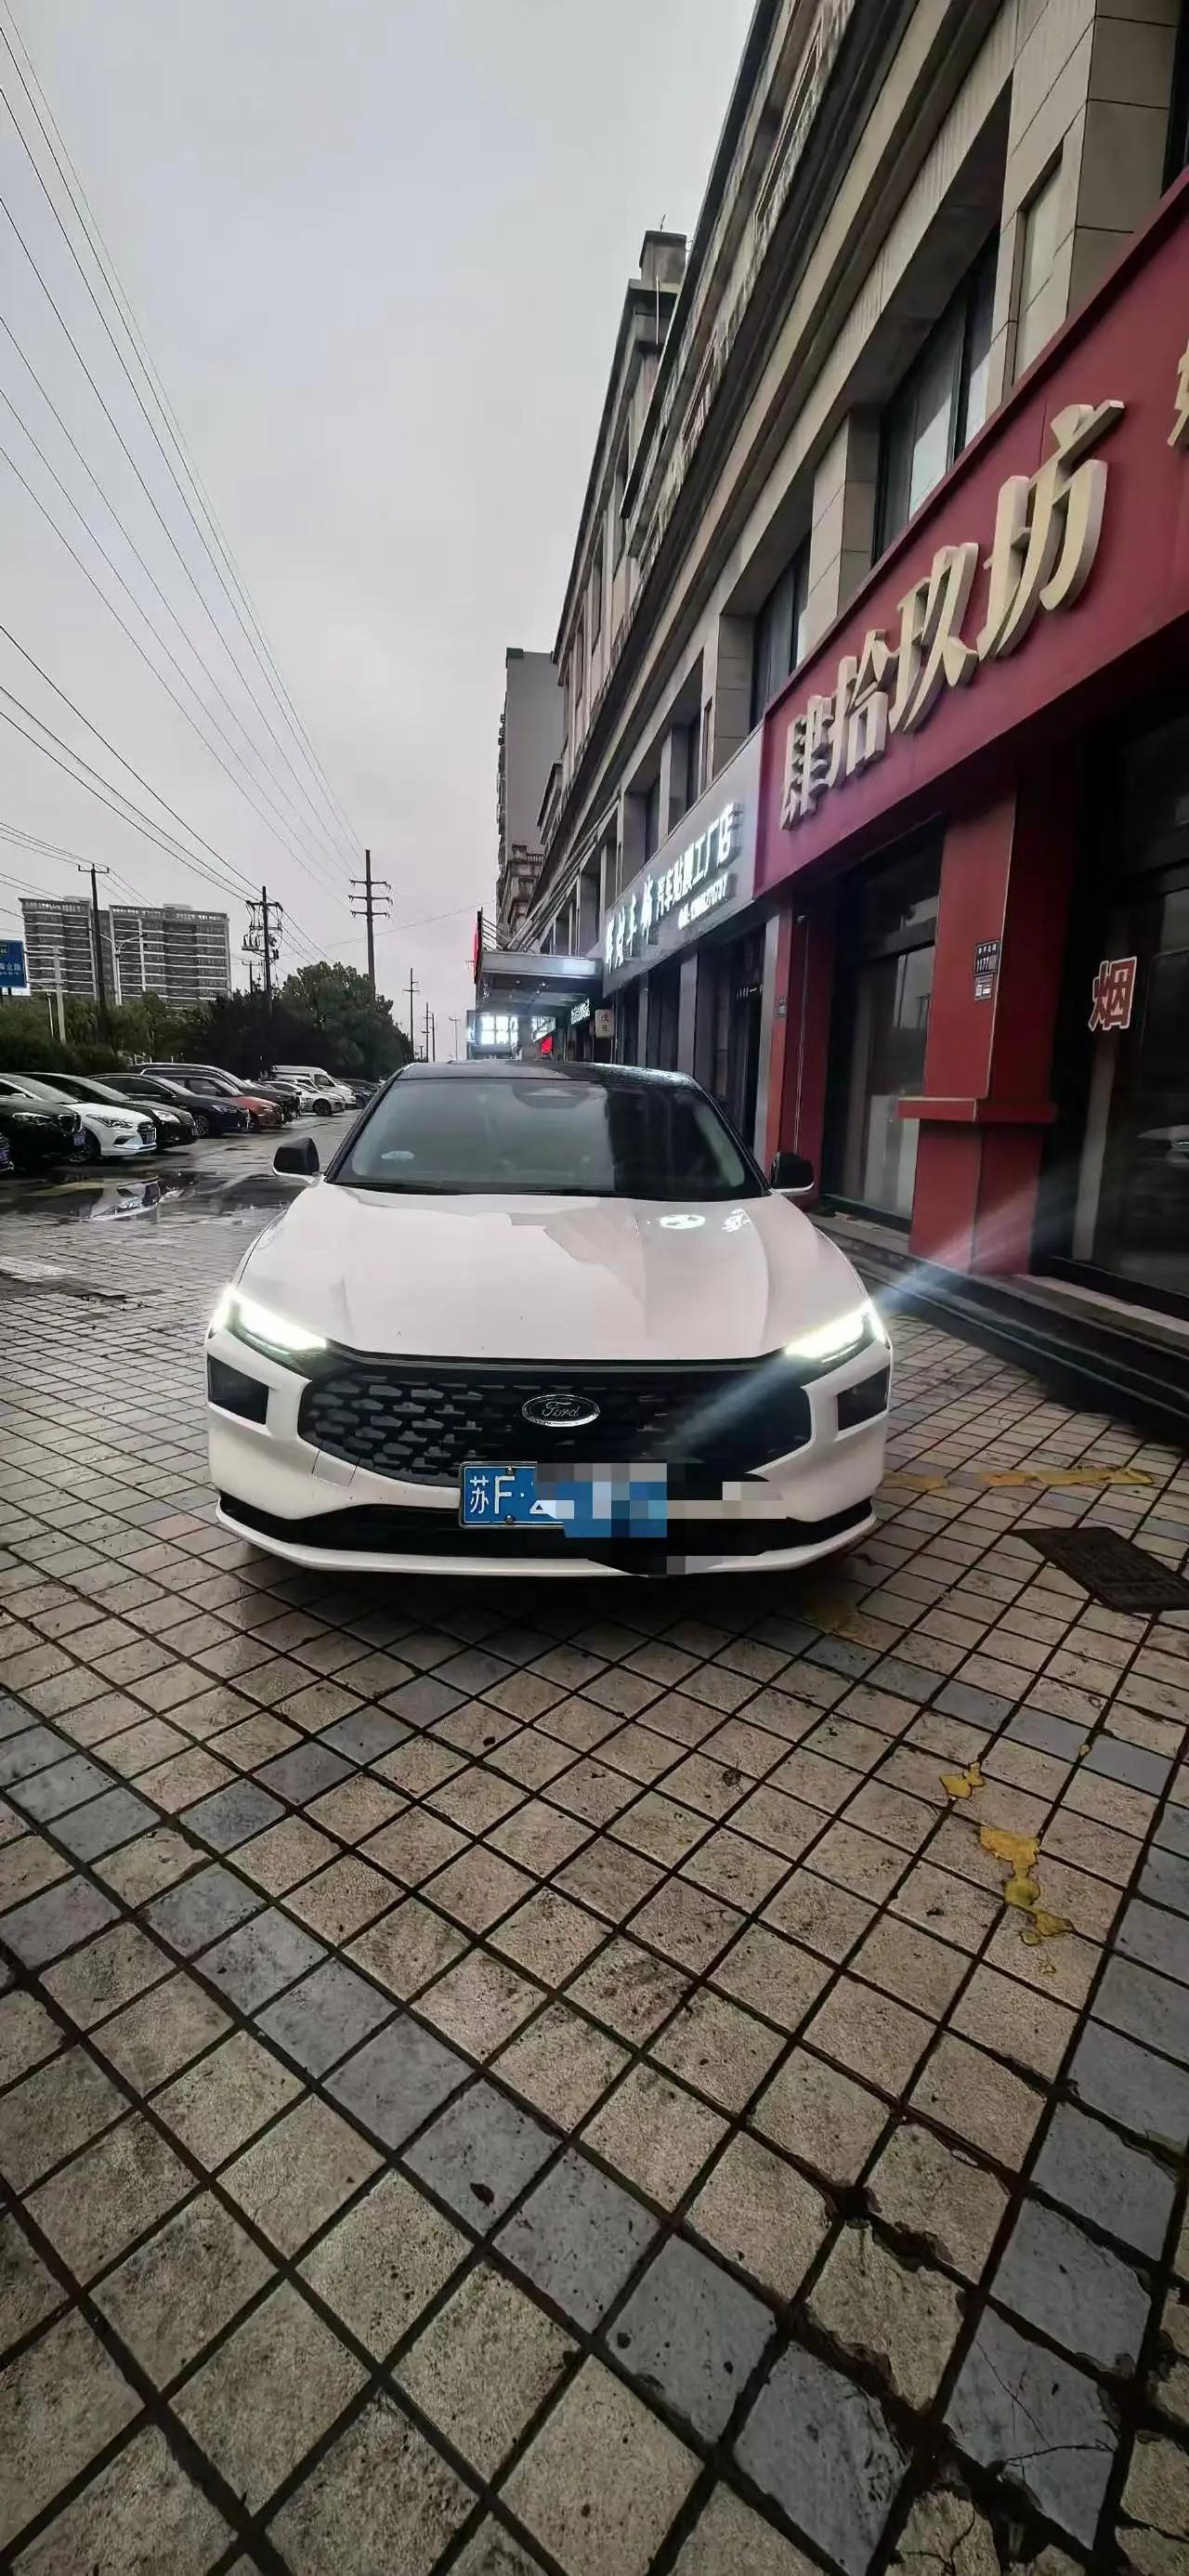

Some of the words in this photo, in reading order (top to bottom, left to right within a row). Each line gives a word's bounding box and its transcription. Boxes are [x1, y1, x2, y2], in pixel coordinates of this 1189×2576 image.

[780, 399, 1125, 830] 肆拾玖坊
[1089, 956, 1137, 1032] 烟
[542, 1401, 581, 1419] Ford
